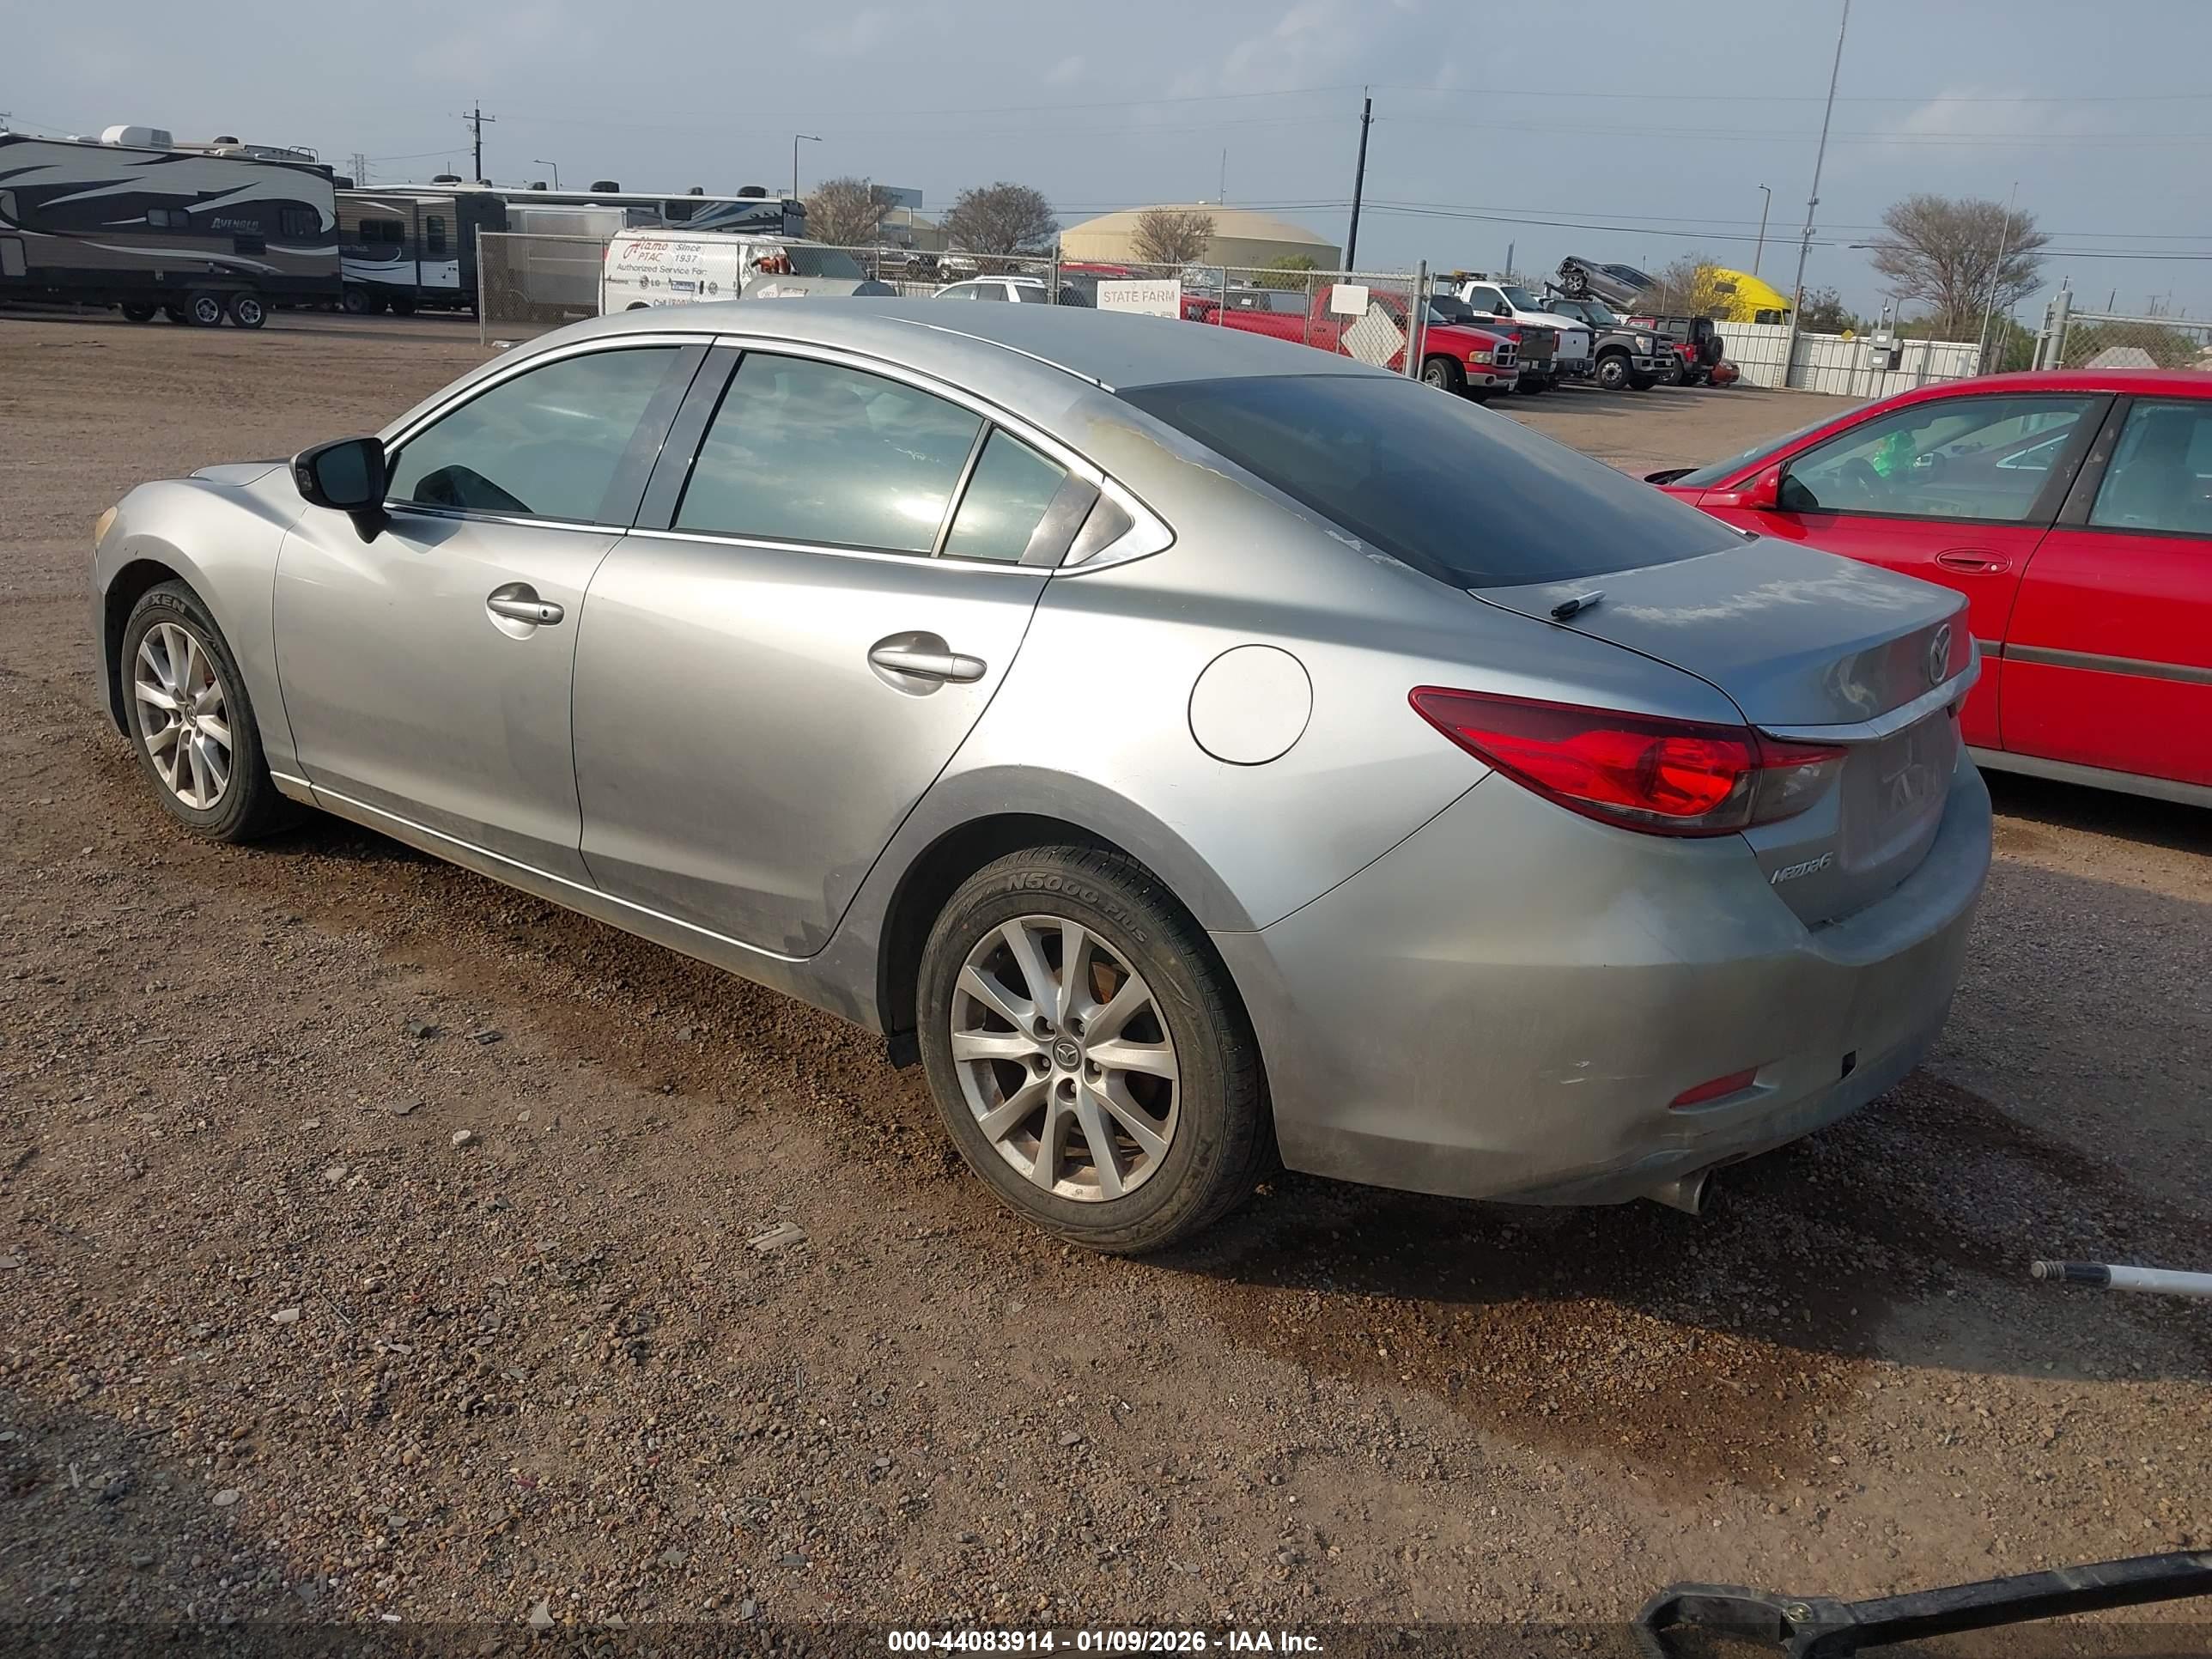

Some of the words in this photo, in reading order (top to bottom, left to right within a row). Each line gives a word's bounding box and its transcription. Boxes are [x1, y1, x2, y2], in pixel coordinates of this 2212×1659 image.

[676, 244, 702, 252] Since
[638, 252, 663, 262] PTAC
[617, 264, 658, 273] Authorized
[659, 265, 690, 275] Service
[1104, 291, 1139, 303] STATE
[1142, 290, 1175, 302] FARM
[1006, 872, 1099, 904] N5000
